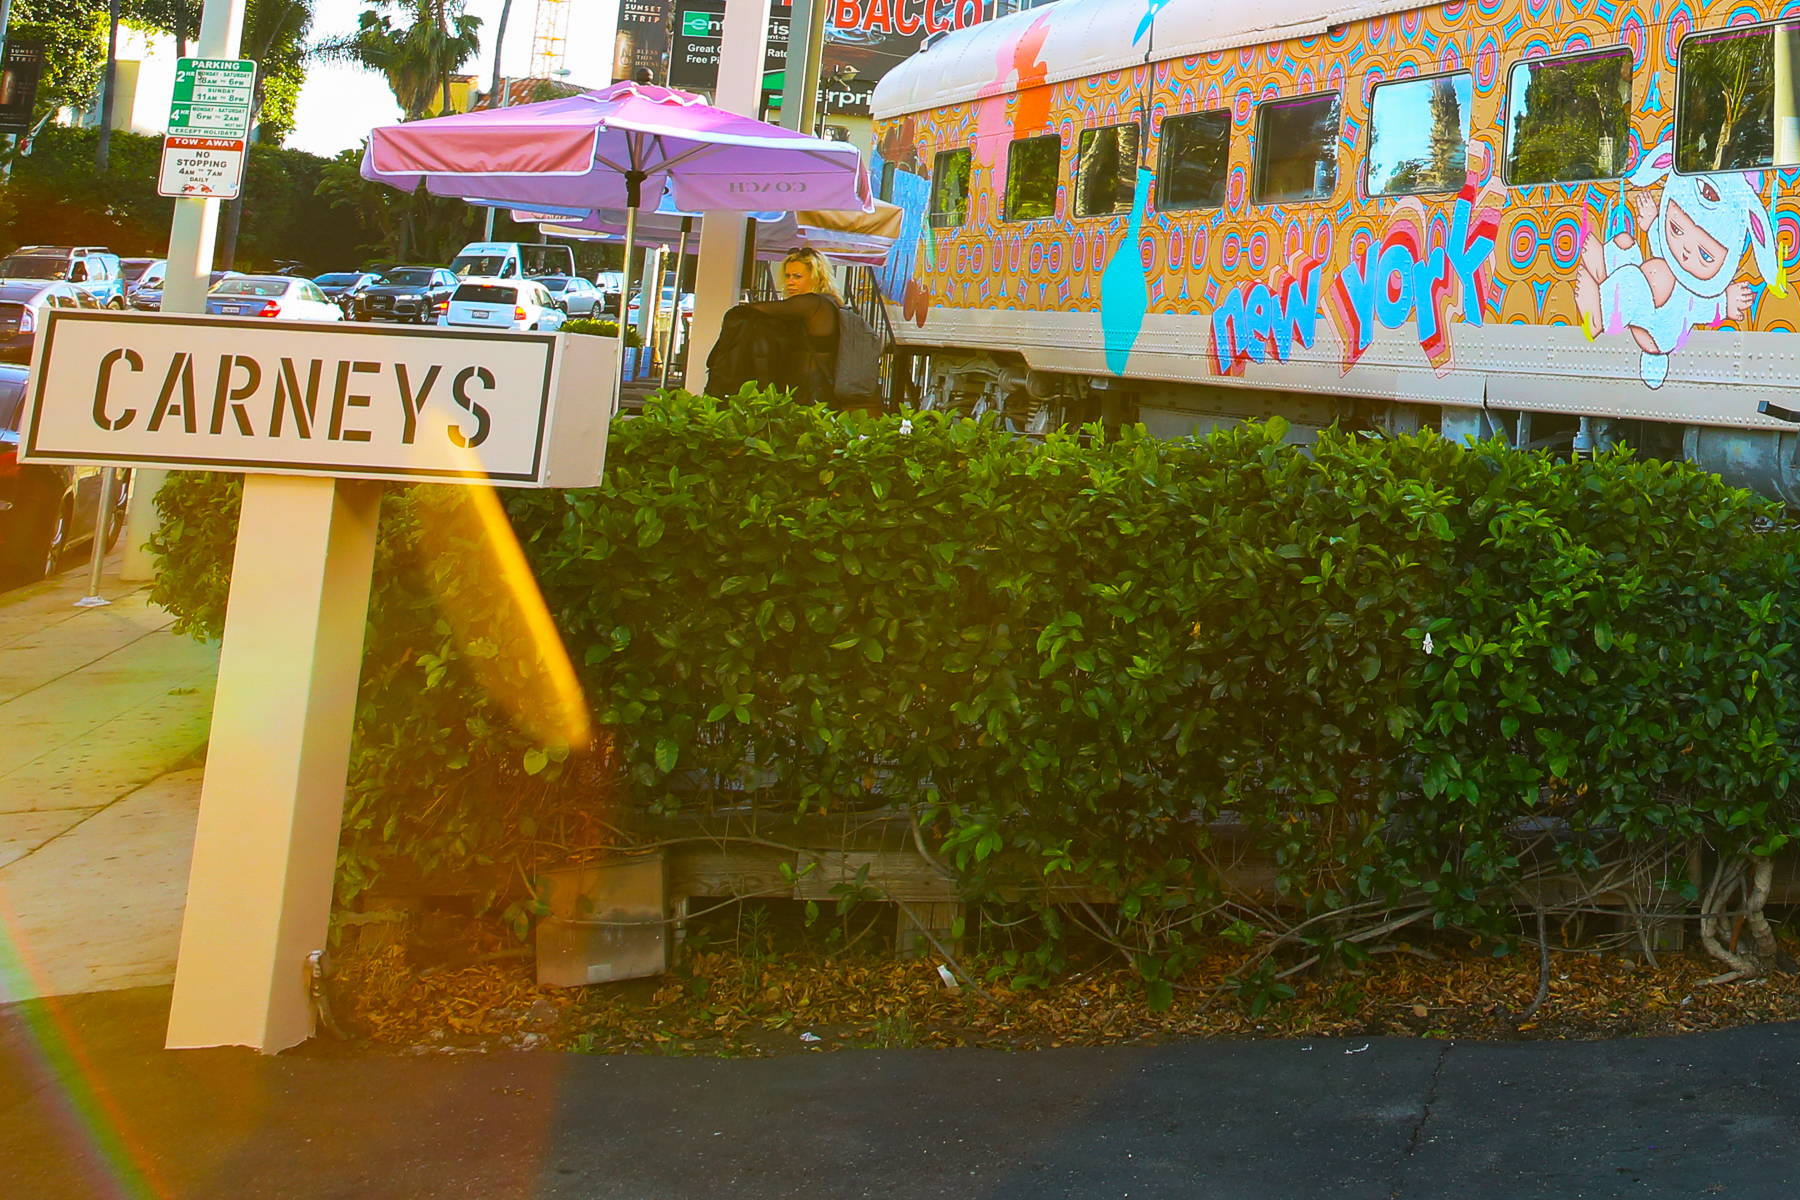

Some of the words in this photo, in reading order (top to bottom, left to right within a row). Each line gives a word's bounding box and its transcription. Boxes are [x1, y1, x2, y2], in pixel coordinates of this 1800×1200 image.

[624, 3, 662, 12] SUNSET
[623, 14, 660, 23] STRIP
[687, 43, 715, 54] Great
[686, 54, 708, 64] Free
[191, 60, 240, 70] PARKING
[228, 94, 245, 102] 8PM
[195, 151, 210, 159] NO
[176, 158, 227, 168] STOPPING
[206, 169, 222, 177] 7AM
[91, 348, 497, 449] CARNEYS
